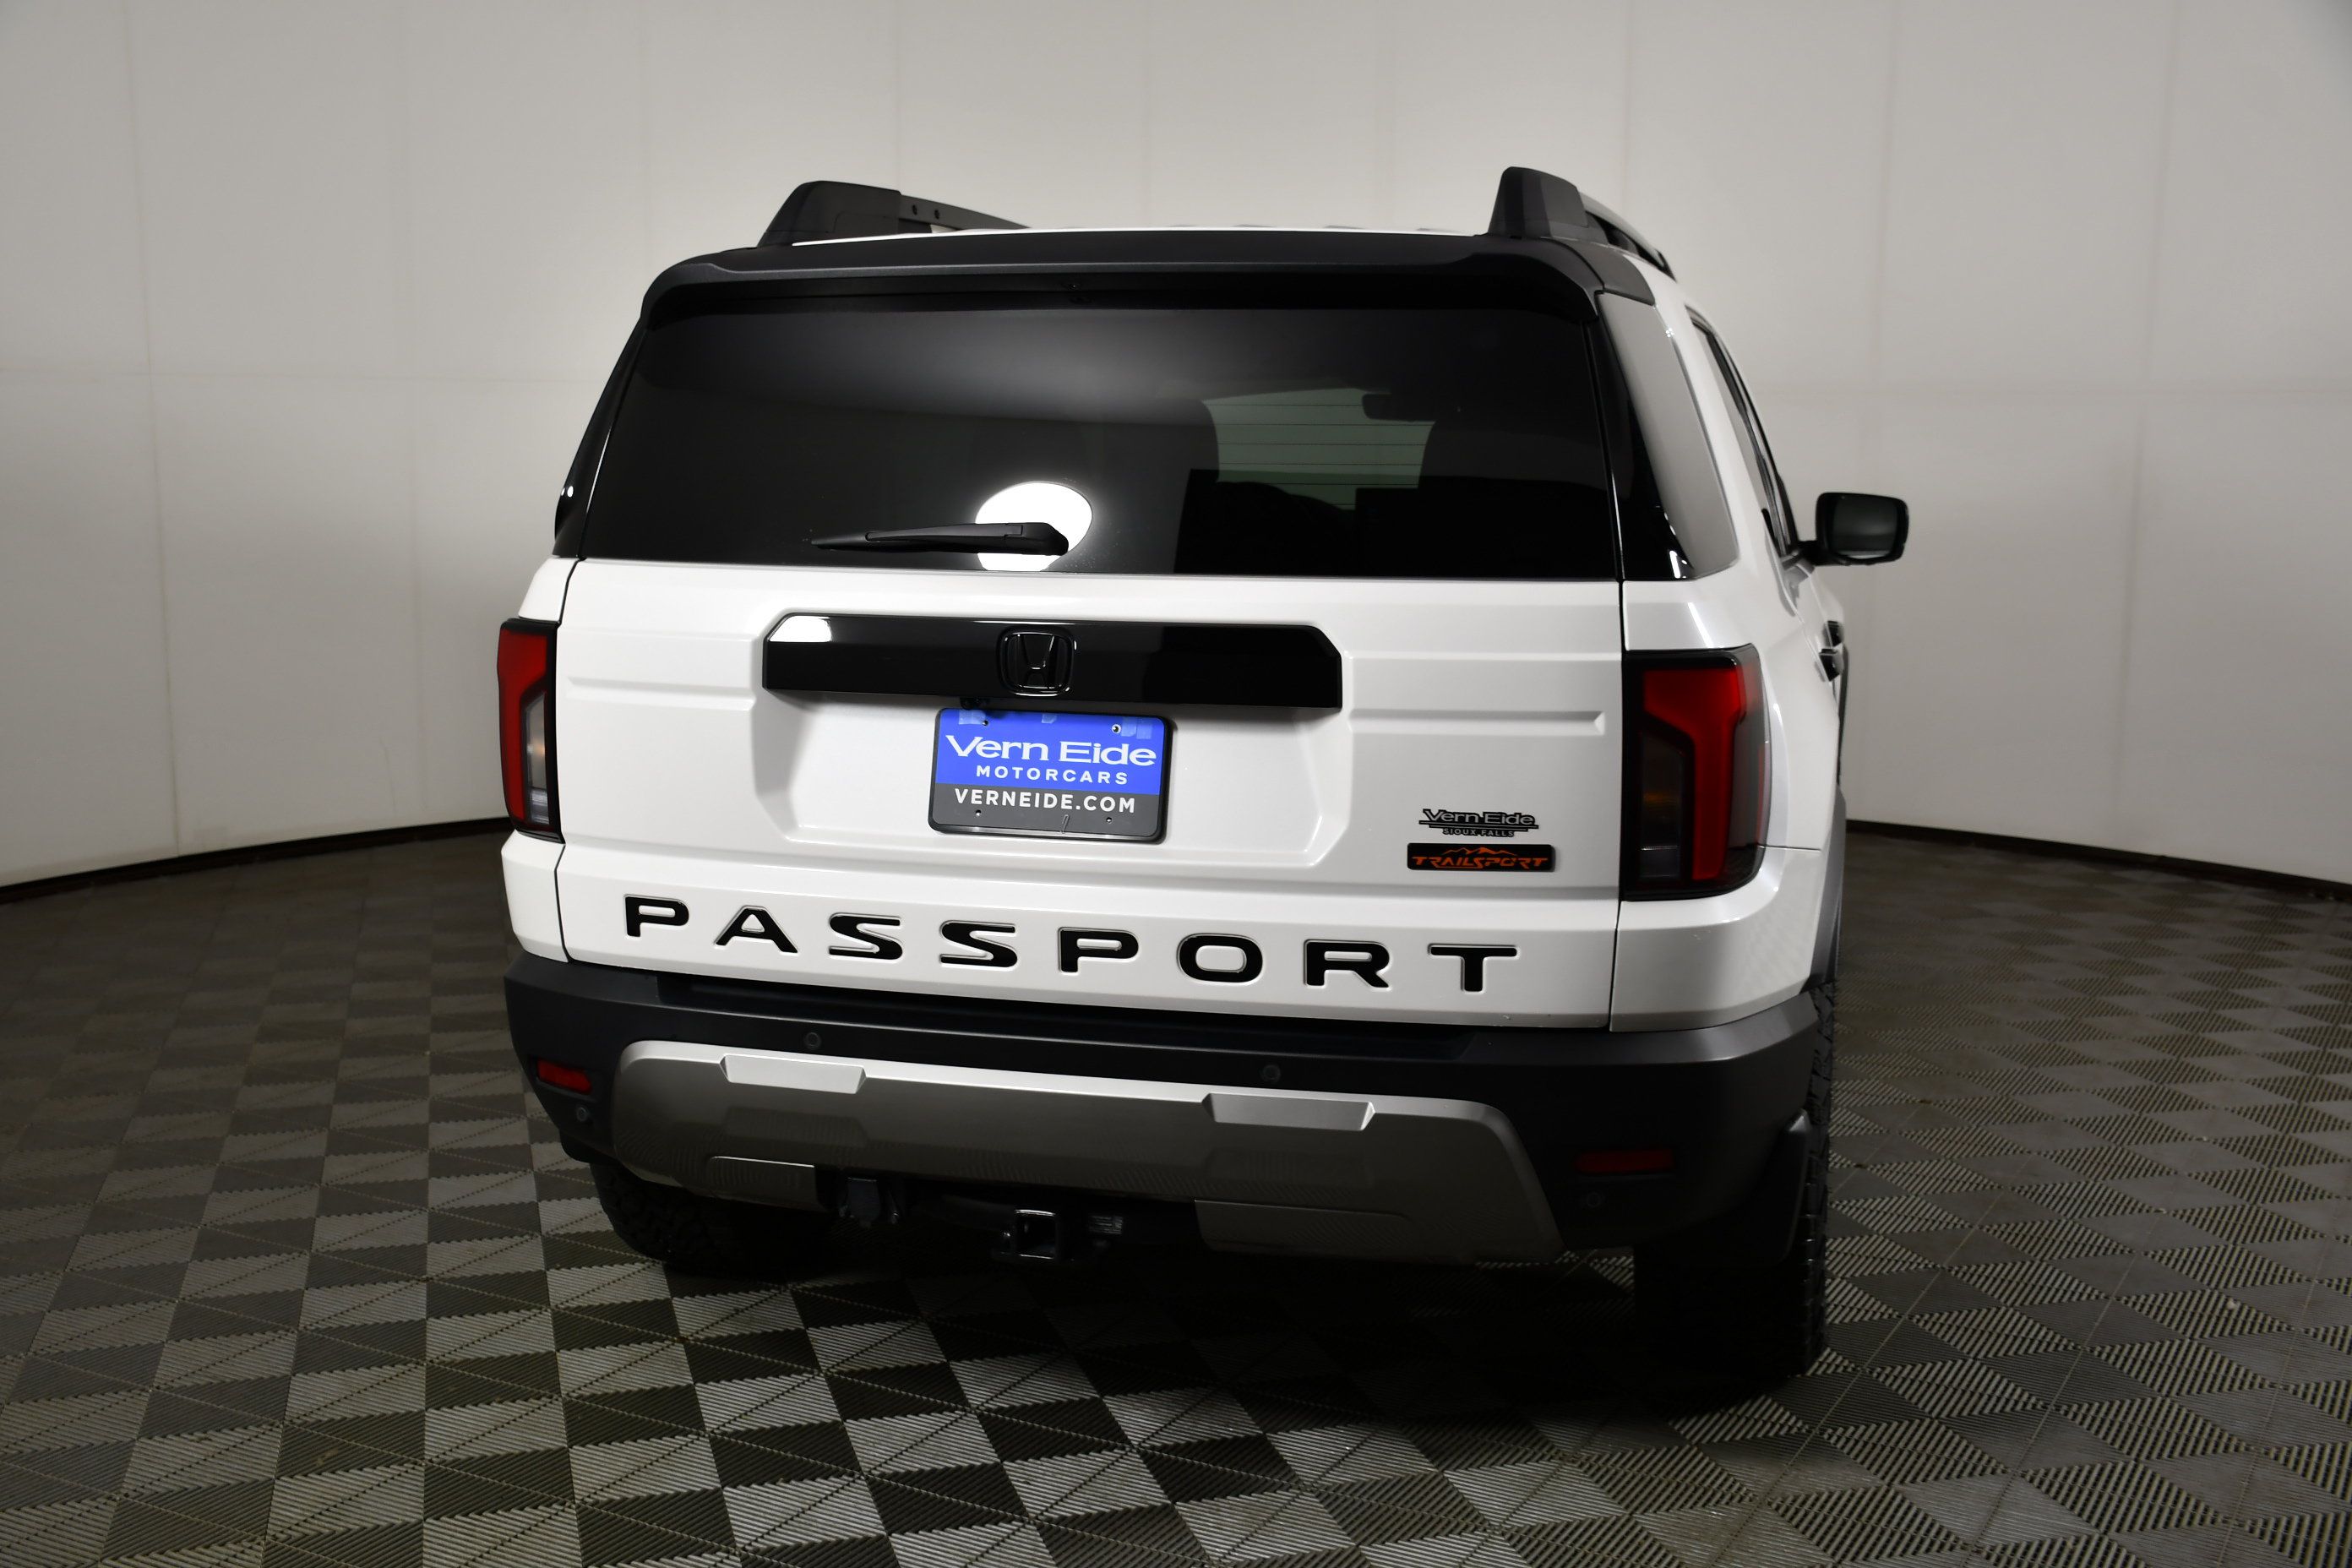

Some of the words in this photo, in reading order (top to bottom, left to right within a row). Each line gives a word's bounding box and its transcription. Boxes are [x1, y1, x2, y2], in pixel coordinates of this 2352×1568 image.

[945, 734, 1049, 761] Vern
[1059, 740, 1157, 766] Eide
[976, 765, 1129, 785] MOTORCARS
[955, 788, 1135, 814] VERNEIDE.COM
[1423, 808, 1479, 824] Vern
[1483, 811, 1536, 825] Eide
[1443, 828, 1477, 836] SIOUX
[1481, 829, 1515, 837] FALLS
[1412, 856, 1549, 869] TRAILSPORT
[623, 893, 1519, 993] PASSPORT
